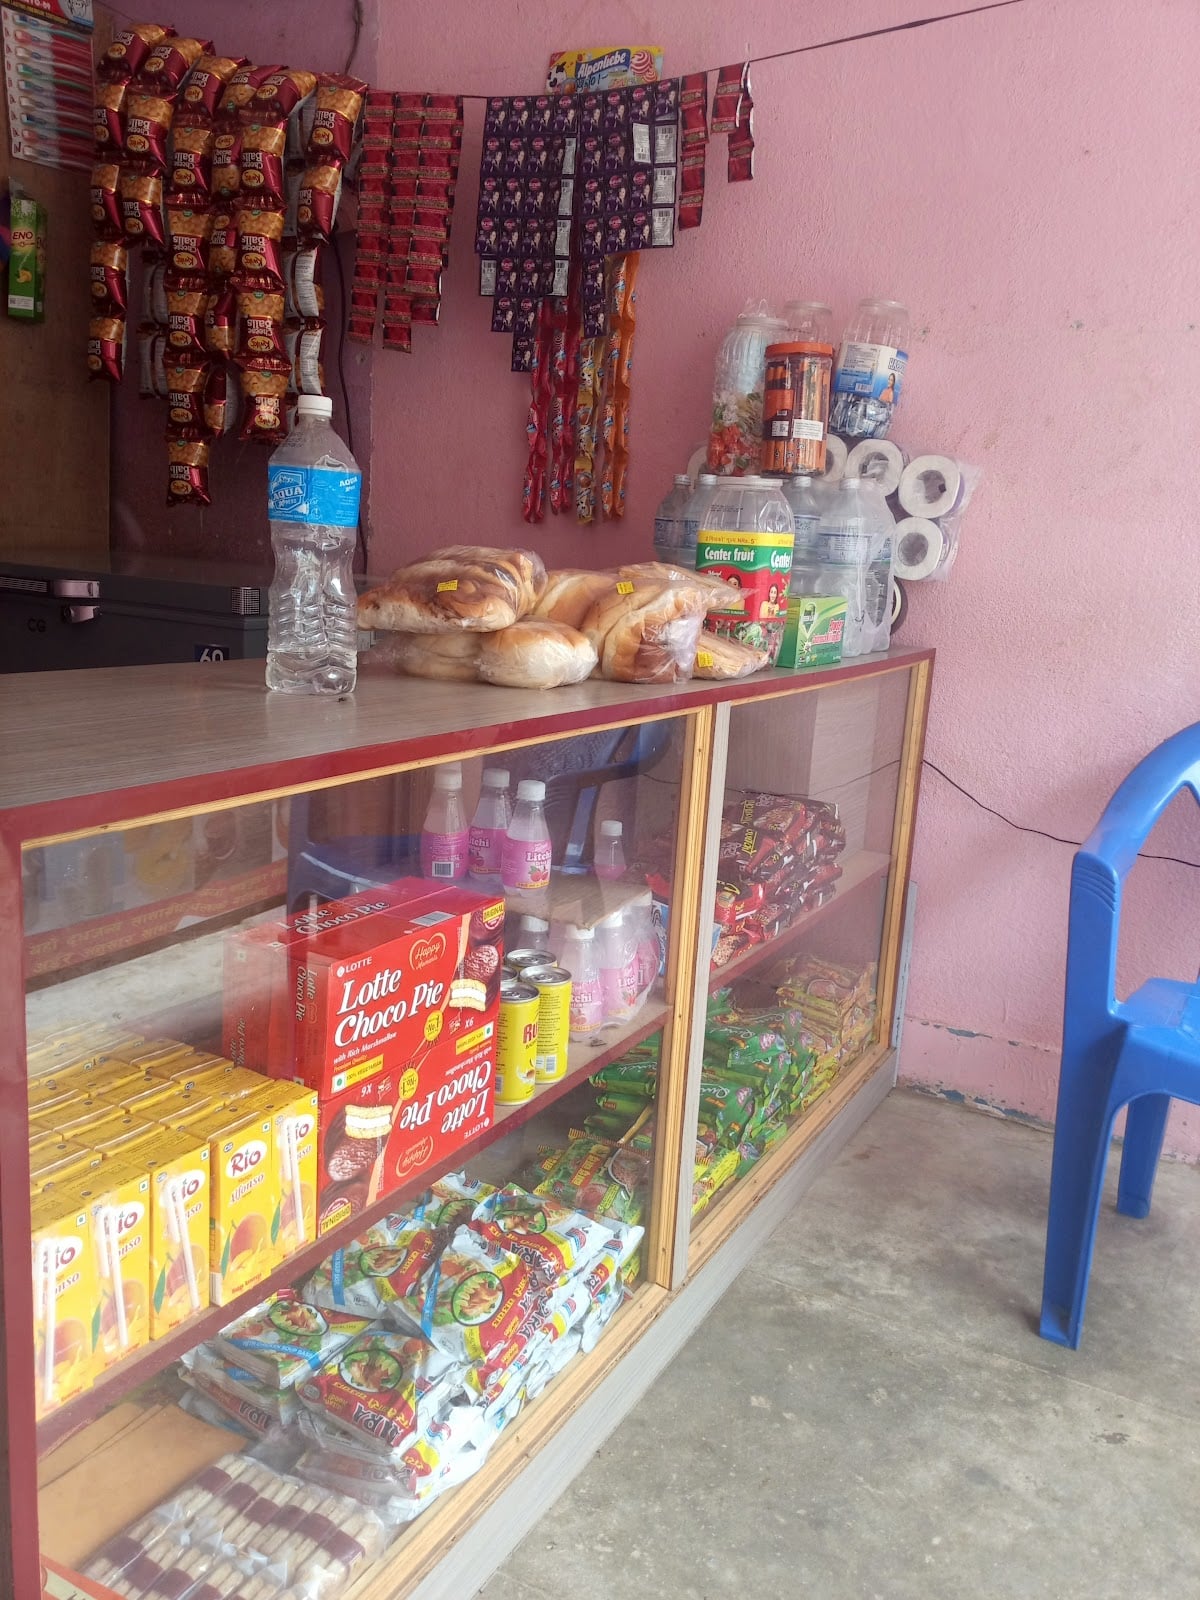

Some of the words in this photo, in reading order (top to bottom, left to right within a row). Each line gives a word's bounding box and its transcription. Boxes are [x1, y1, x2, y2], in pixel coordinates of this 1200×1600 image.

[577, 50, 626, 78] Alpenliebe
[12, 231, 33, 239] ENO
[173, 236, 197, 247] Balls
[247, 319, 273, 330] Balls
[705, 546, 731, 561] Center
[734, 547, 755, 562] fruit
[296, 913, 358, 934] Choco
[353, 901, 389, 915] Pie
[415, 942, 441, 961] Happy
[345, 956, 373, 973] LOTTE
[296, 965, 306, 1001] Choco
[306, 969, 317, 1000] Lotte
[337, 968, 402, 1015] Lotte
[296, 1002, 305, 1021] Pie
[335, 1001, 407, 1048] Choco
[409, 979, 444, 1017] Pie
[361, 1032, 398, 1053] Marshmallow
[437, 1060, 492, 1107] Choco
[400, 1090, 436, 1131] Pie
[441, 1087, 491, 1134] Lotte
[295, 1123, 310, 1142] io
[463, 1123, 485, 1139] LOTTE
[231, 1149, 261, 1177] Rio
[182, 1178, 200, 1200] io
[230, 1173, 265, 1204] Alfonso
[117, 1211, 138, 1234] io
[55, 1246, 76, 1270] io
